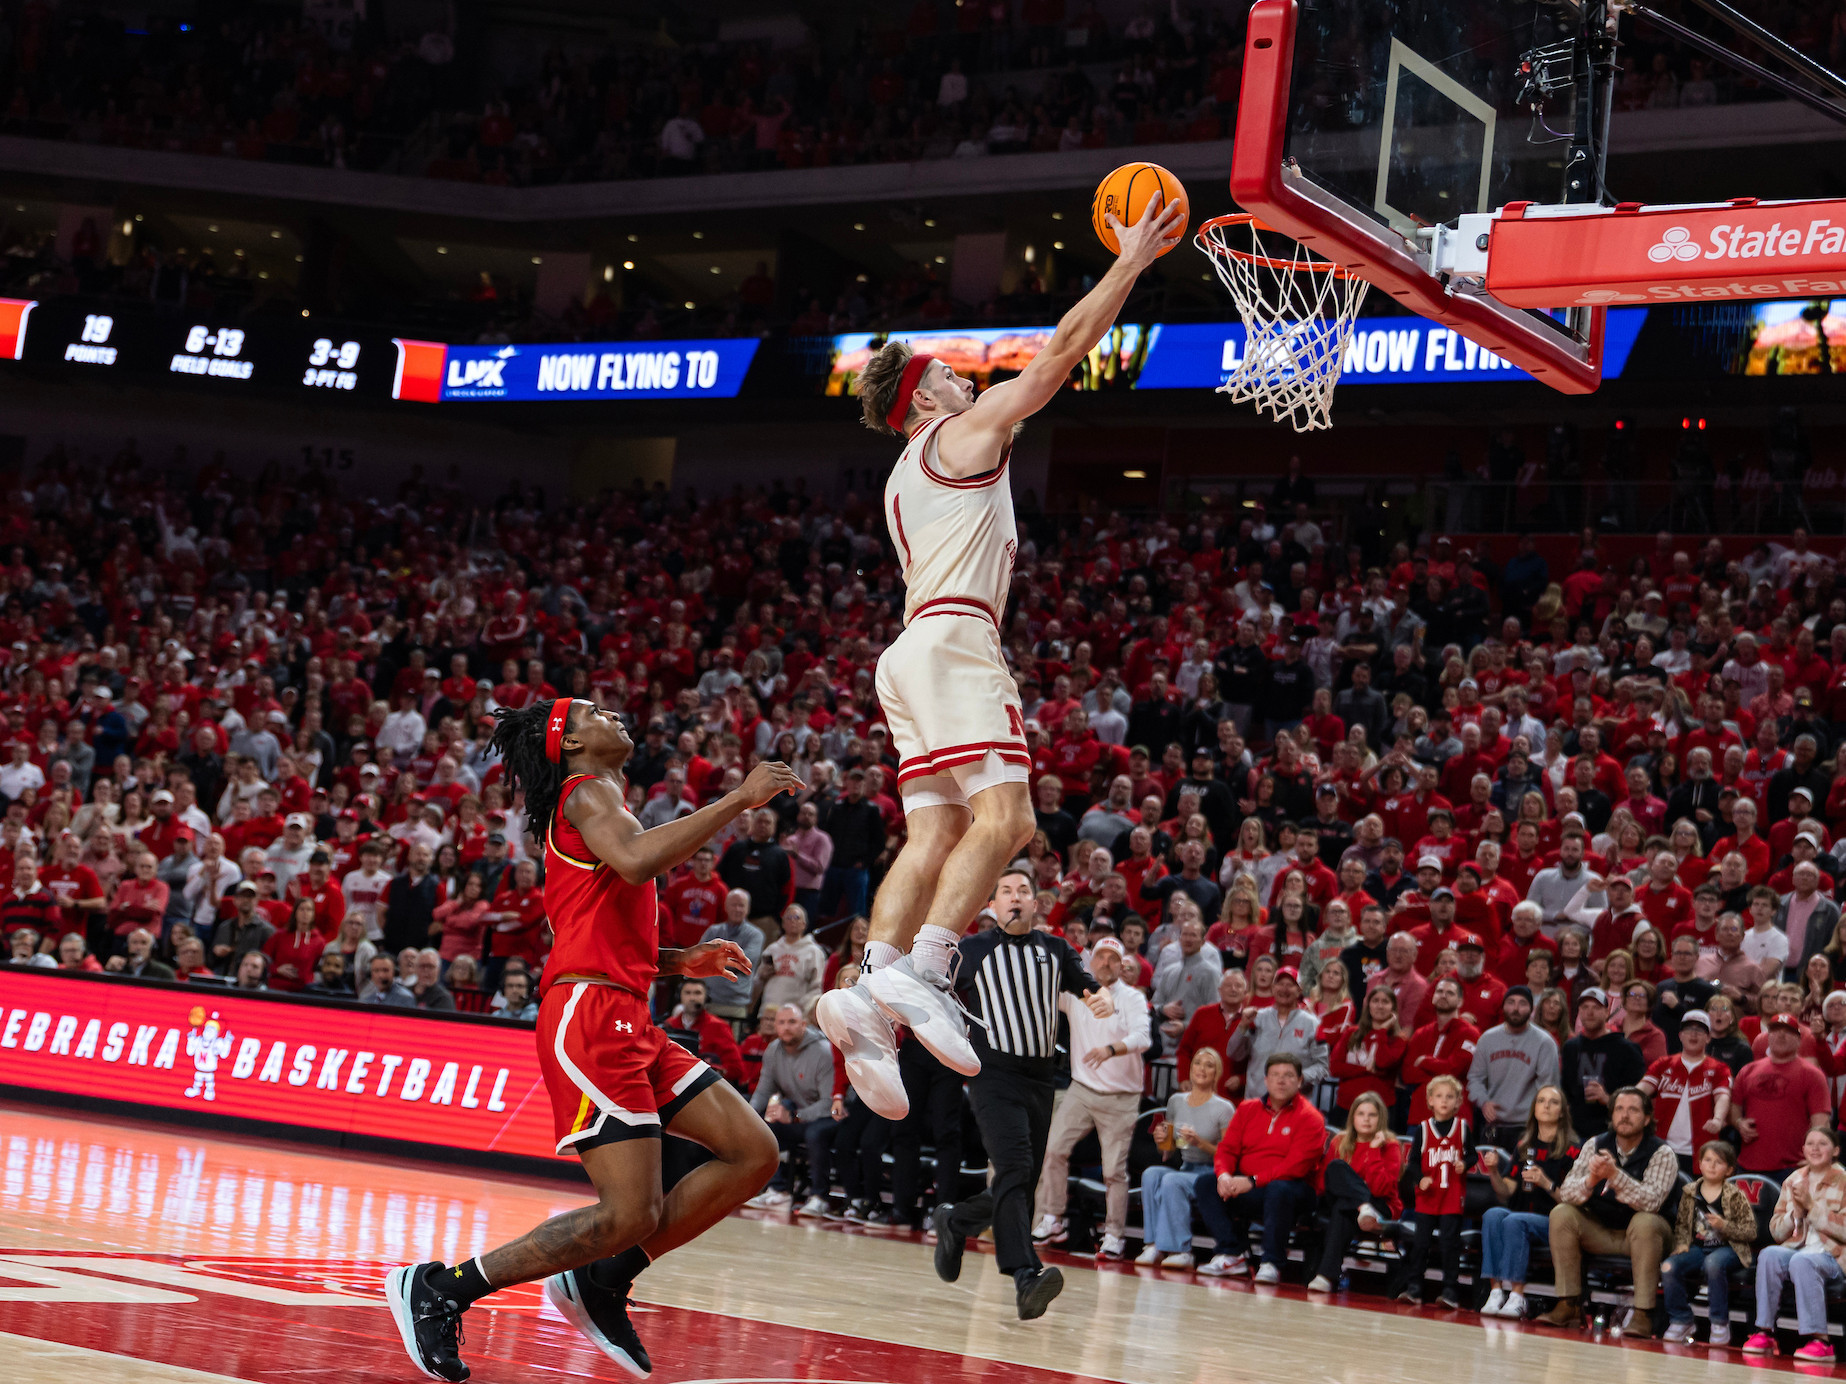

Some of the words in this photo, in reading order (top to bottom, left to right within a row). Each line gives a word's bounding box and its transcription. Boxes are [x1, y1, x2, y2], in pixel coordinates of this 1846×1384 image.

[1704, 223, 1801, 260] State
[1648, 282, 1780, 299] State
[81, 314, 113, 343] 19
[185, 325, 245, 357] 6-13
[64, 343, 118, 365] POINTS
[170, 354, 209, 375] FIELD
[309, 338, 361, 369] 3-9
[1342, 329, 1419, 373] NOW
[537, 354, 597, 391] NOW
[597, 351, 681, 390] FLYING
[686, 350, 719, 389] TO
[0, 1007, 181, 1070] EBRASKA
[231, 1037, 511, 1113] BASKETBALL
[1440, 1163, 1448, 1188] 1
